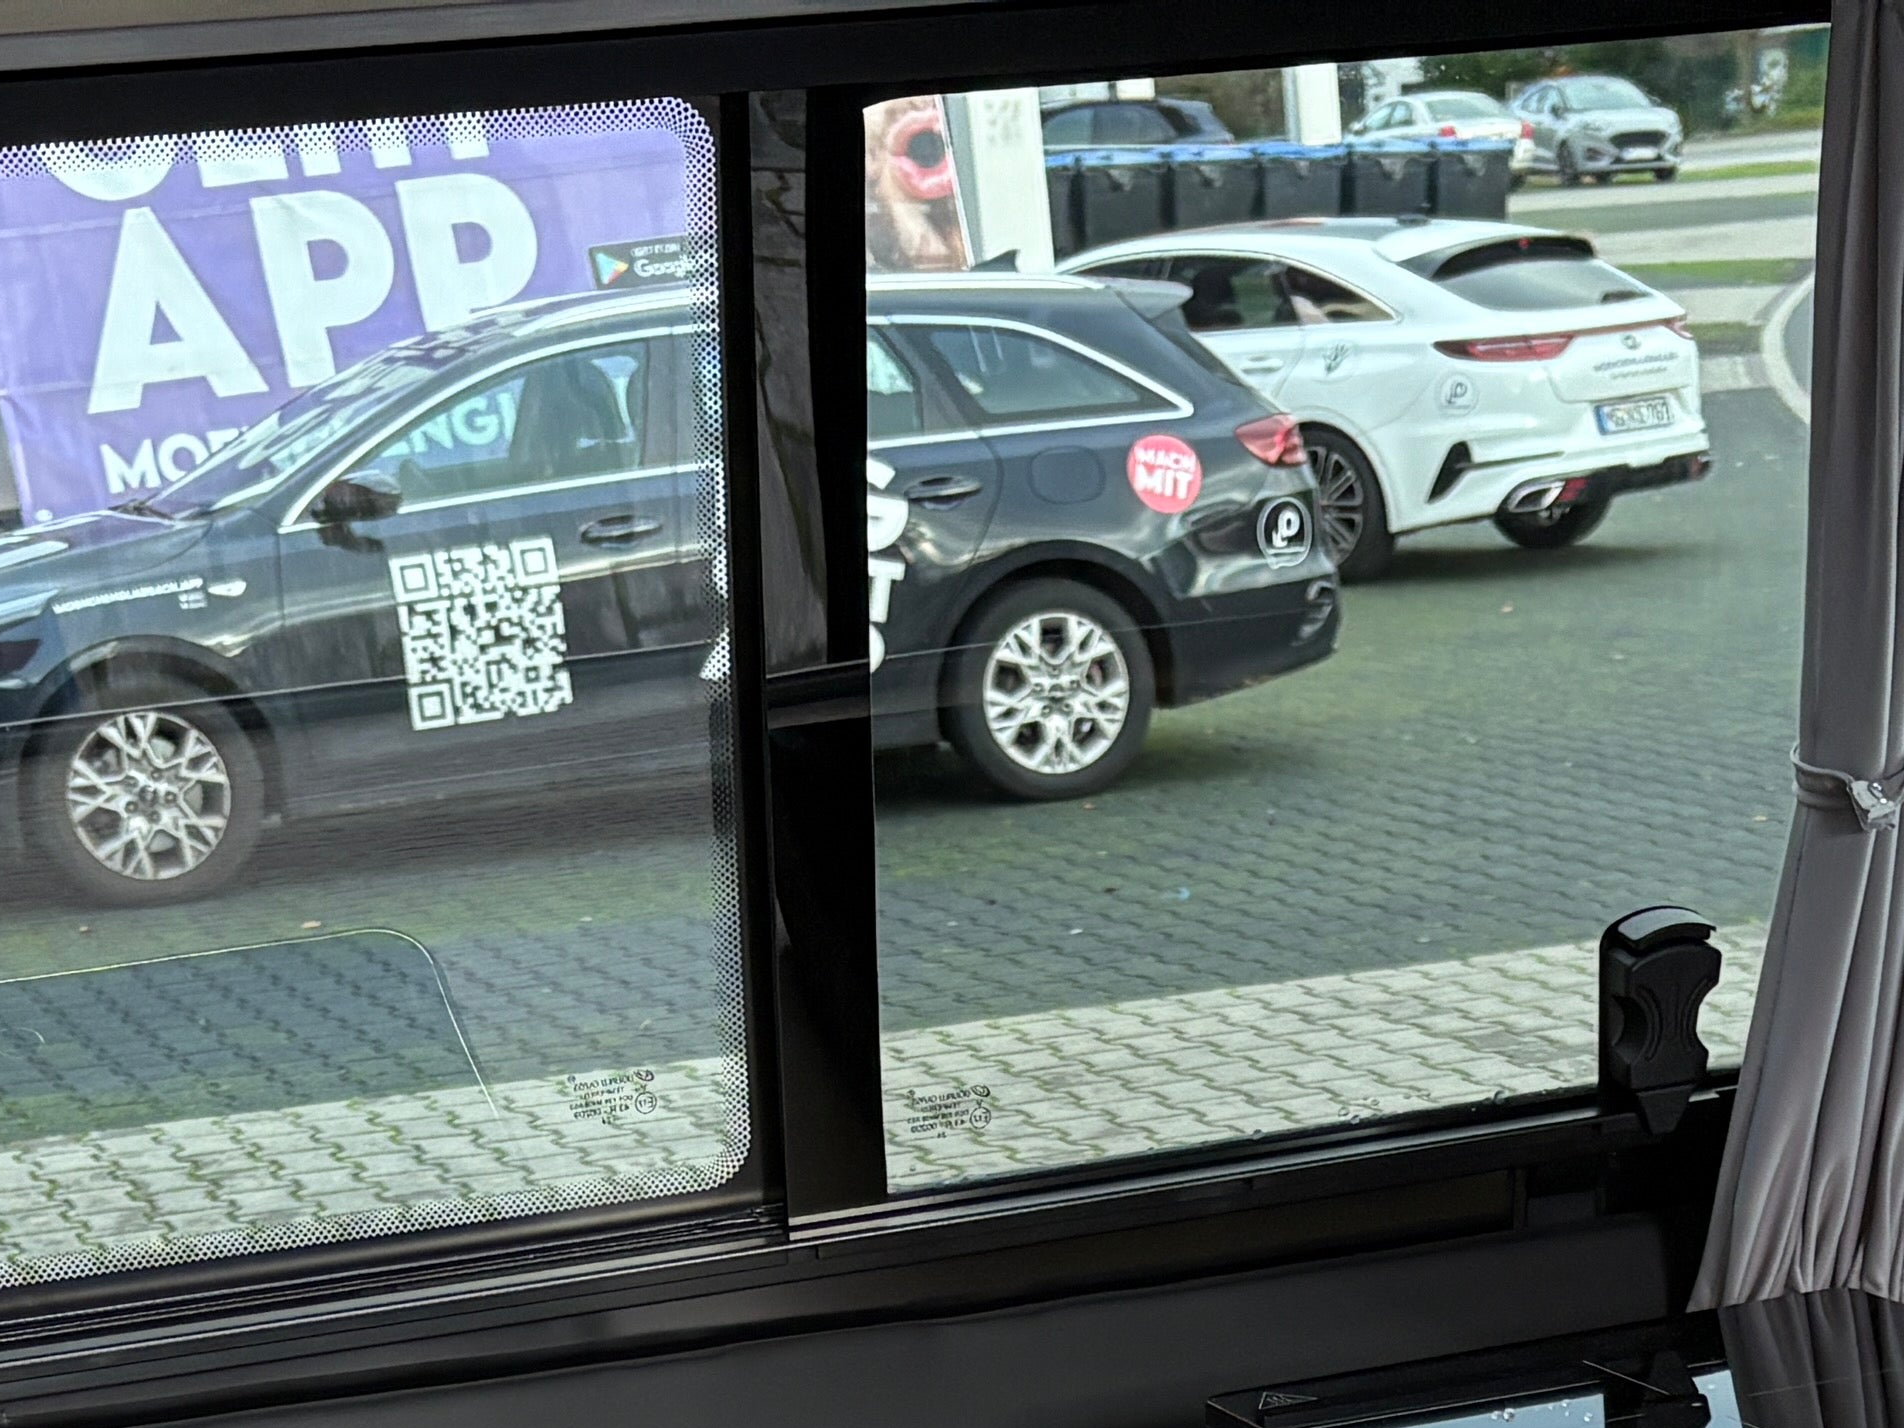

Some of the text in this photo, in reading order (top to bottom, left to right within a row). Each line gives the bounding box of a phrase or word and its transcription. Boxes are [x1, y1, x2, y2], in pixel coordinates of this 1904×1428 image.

[88, 173, 538, 415] APP
[1134, 446, 1196, 472] MACH
[1135, 464, 1194, 500] MIT
